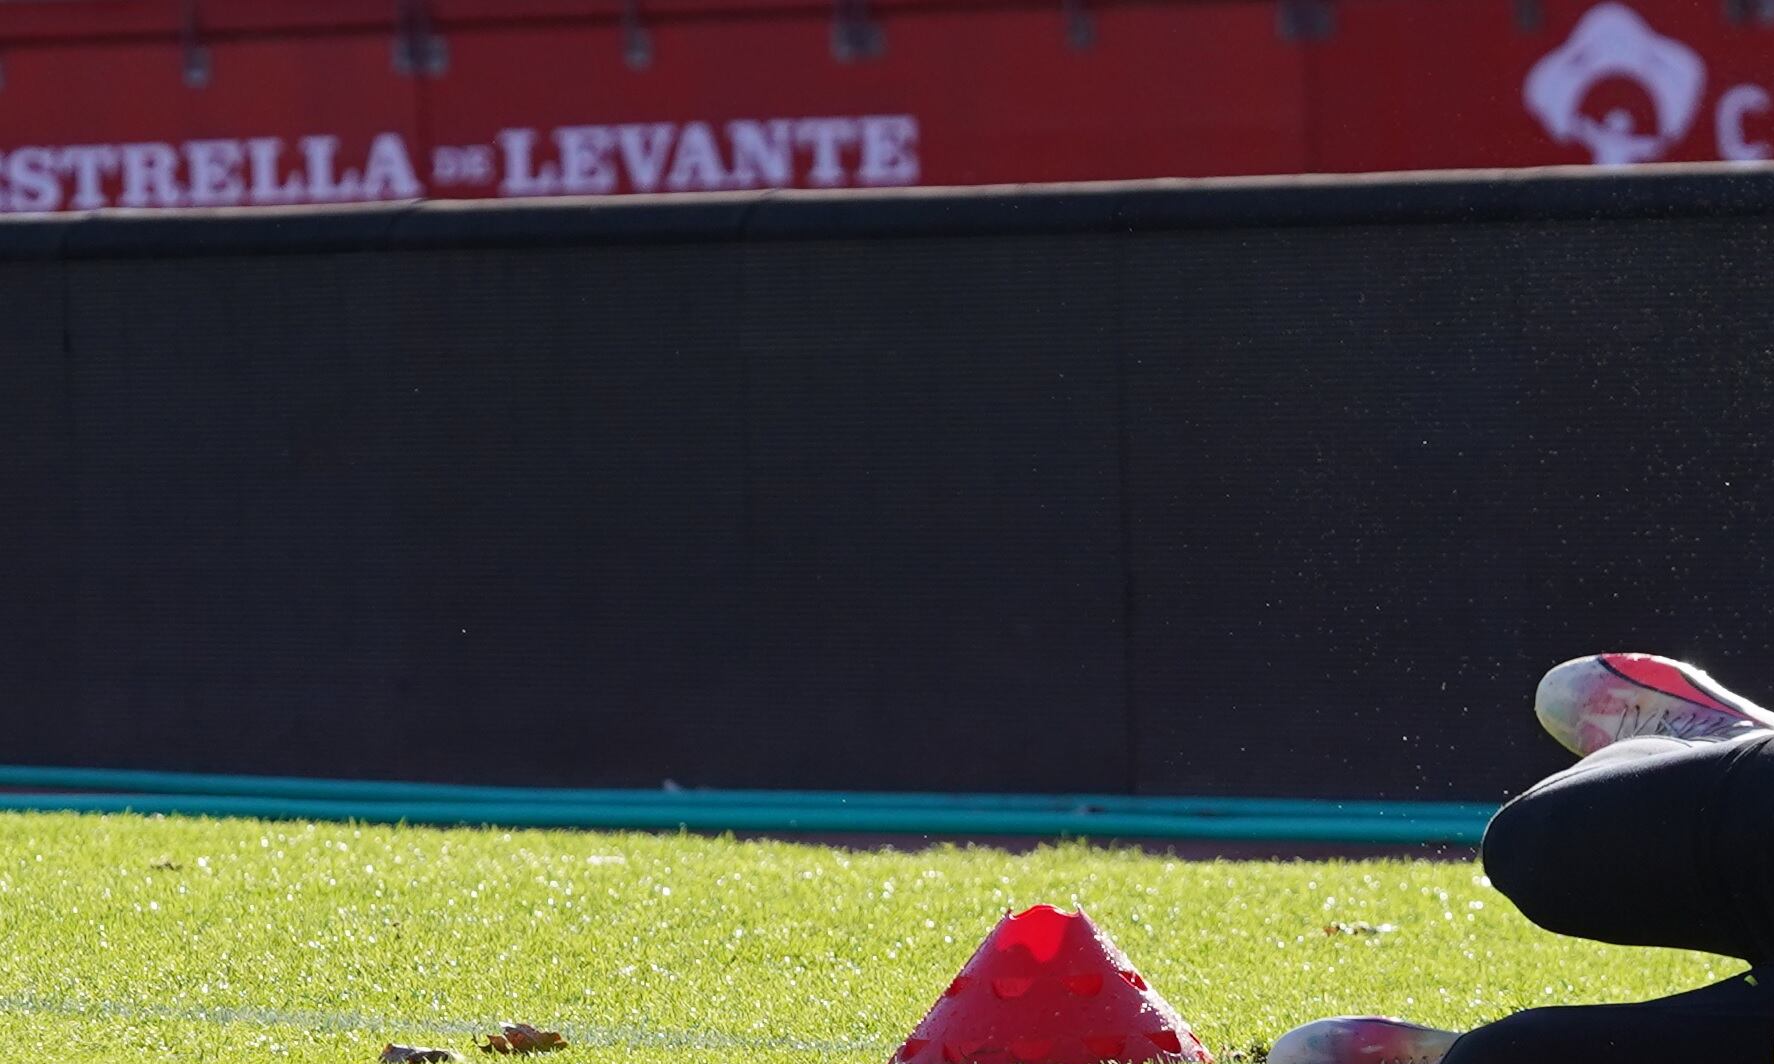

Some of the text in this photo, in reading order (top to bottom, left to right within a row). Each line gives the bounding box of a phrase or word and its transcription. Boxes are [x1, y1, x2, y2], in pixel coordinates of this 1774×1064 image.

[0, 115, 922, 213] STRELLA DE LEVANTE
